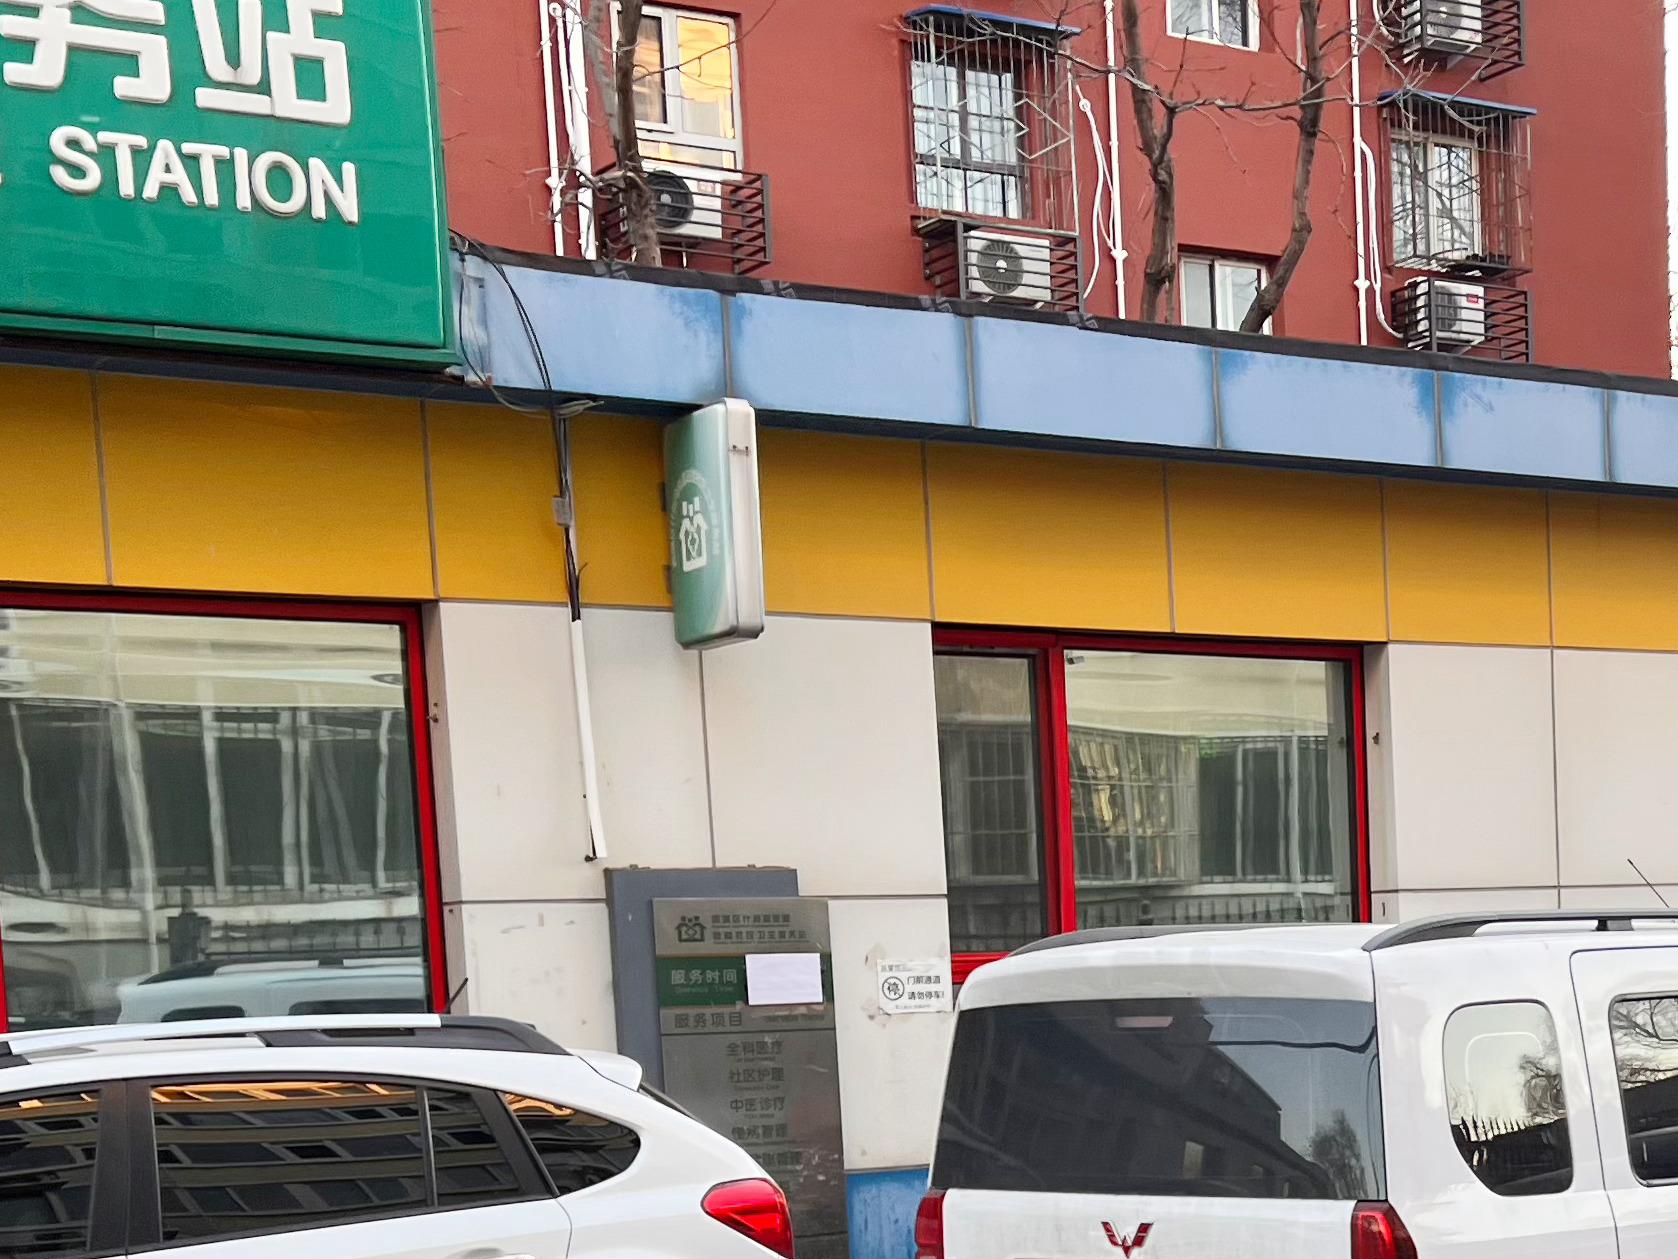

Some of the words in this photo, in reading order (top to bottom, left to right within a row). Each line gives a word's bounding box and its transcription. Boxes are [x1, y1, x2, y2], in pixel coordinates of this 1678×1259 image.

[49, 125, 359, 224] STATION
[671, 968, 738, 985] 服务时间
[907, 975, 941, 985] 门前通道
[674, 1011, 743, 1029] 服务项目
[726, 1040, 784, 1057] 全科医疗
[729, 1066, 785, 1084] 社区护理
[729, 1096, 786, 1113] 中医诊疗
